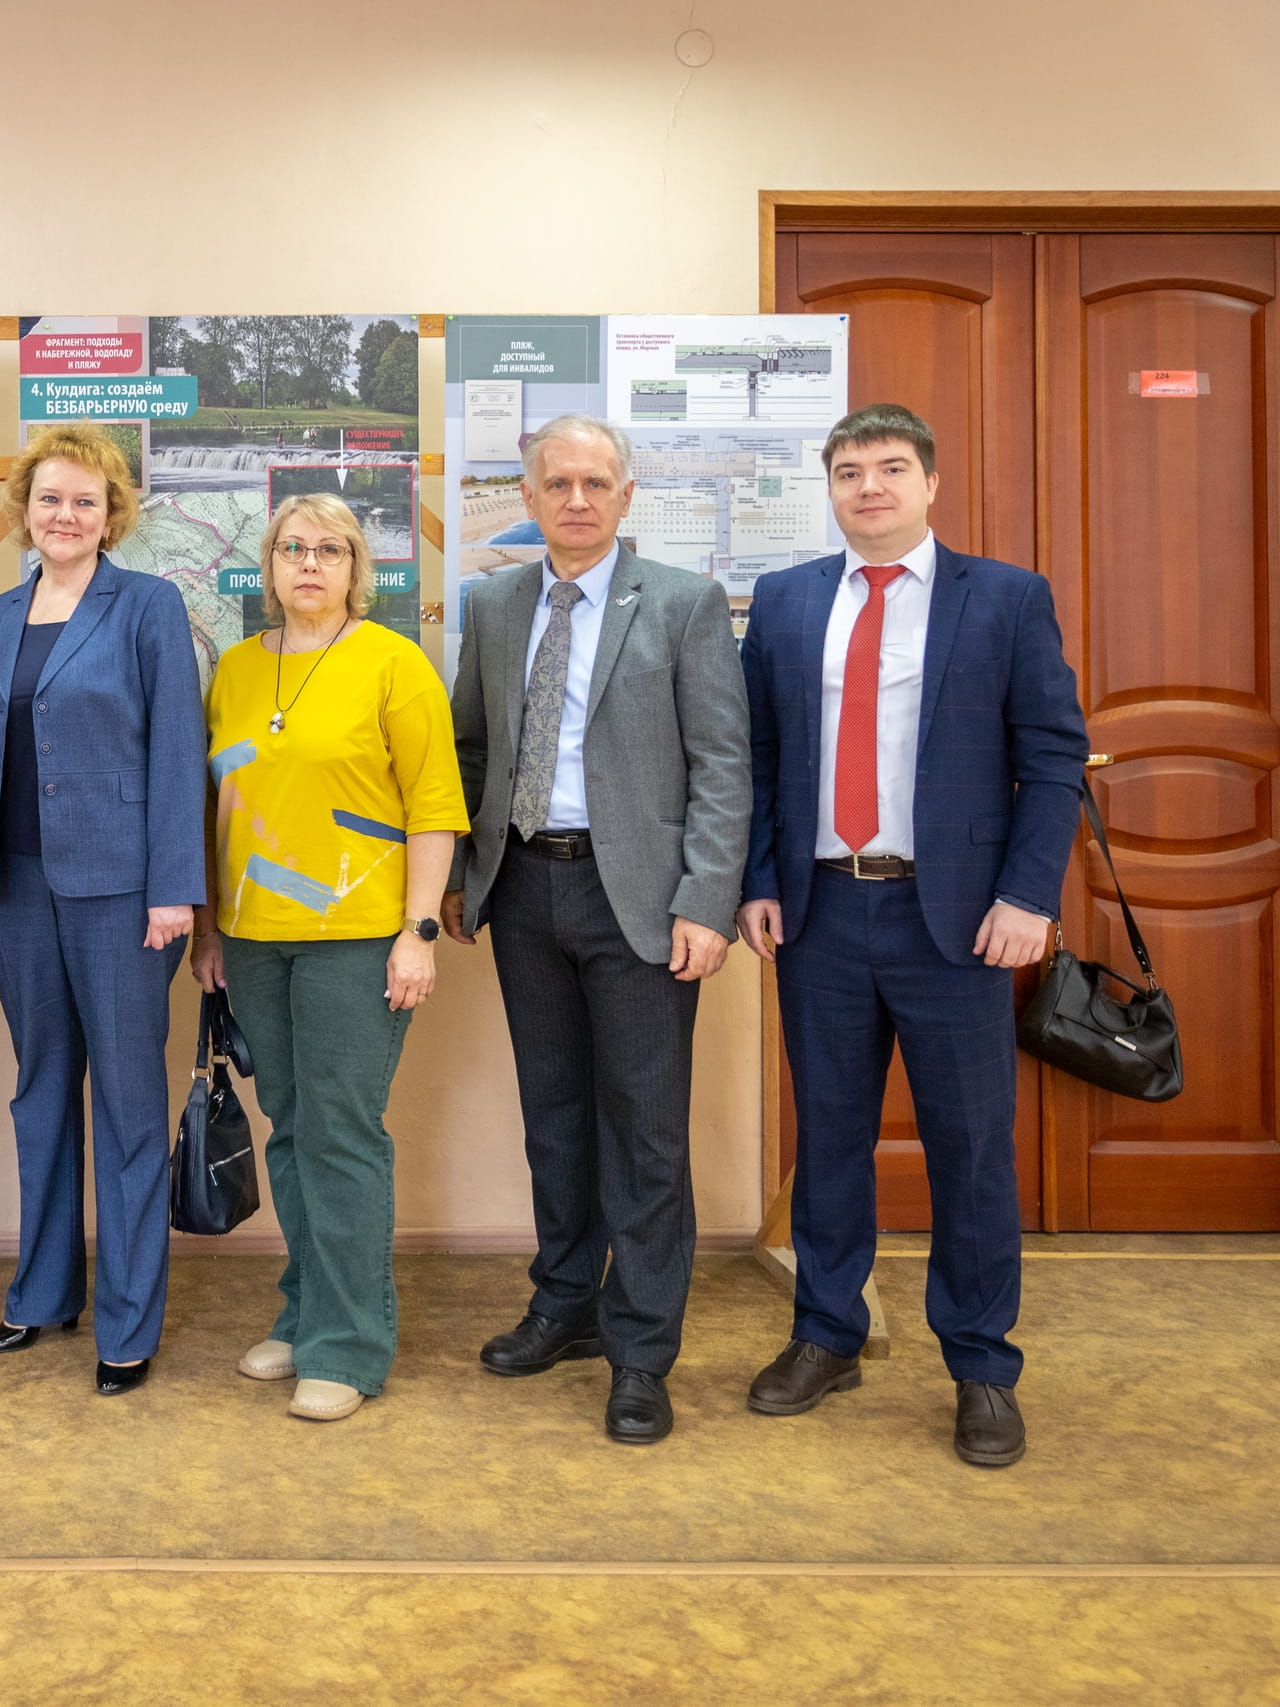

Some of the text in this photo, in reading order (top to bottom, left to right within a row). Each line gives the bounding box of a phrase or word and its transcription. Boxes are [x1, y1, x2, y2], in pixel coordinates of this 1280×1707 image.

[46, 338, 122, 347] ФРАГМЕНТ: ПОДХОДЫ
[511, 341, 534, 350] ПЛЯЖ,
[42, 349, 93, 358] НАБЕРЕЖНОЙ,
[94, 349, 133, 358] ВОДОПАДУ
[500, 352, 545, 362] ДОСТУПНЫЙ
[492, 364, 554, 373] ДЛЯ ИНВАЛИДОВ
[31, 381, 163, 399] 4. Кулдига: создаём
[46, 400, 188, 416] БЕЗБАРЬЕРНУЮ среду
[346, 430, 404, 439] СУЩЕСТВУЮЩЕЕ
[230, 572, 405, 588] ПРОЕ ЕНИЕ
